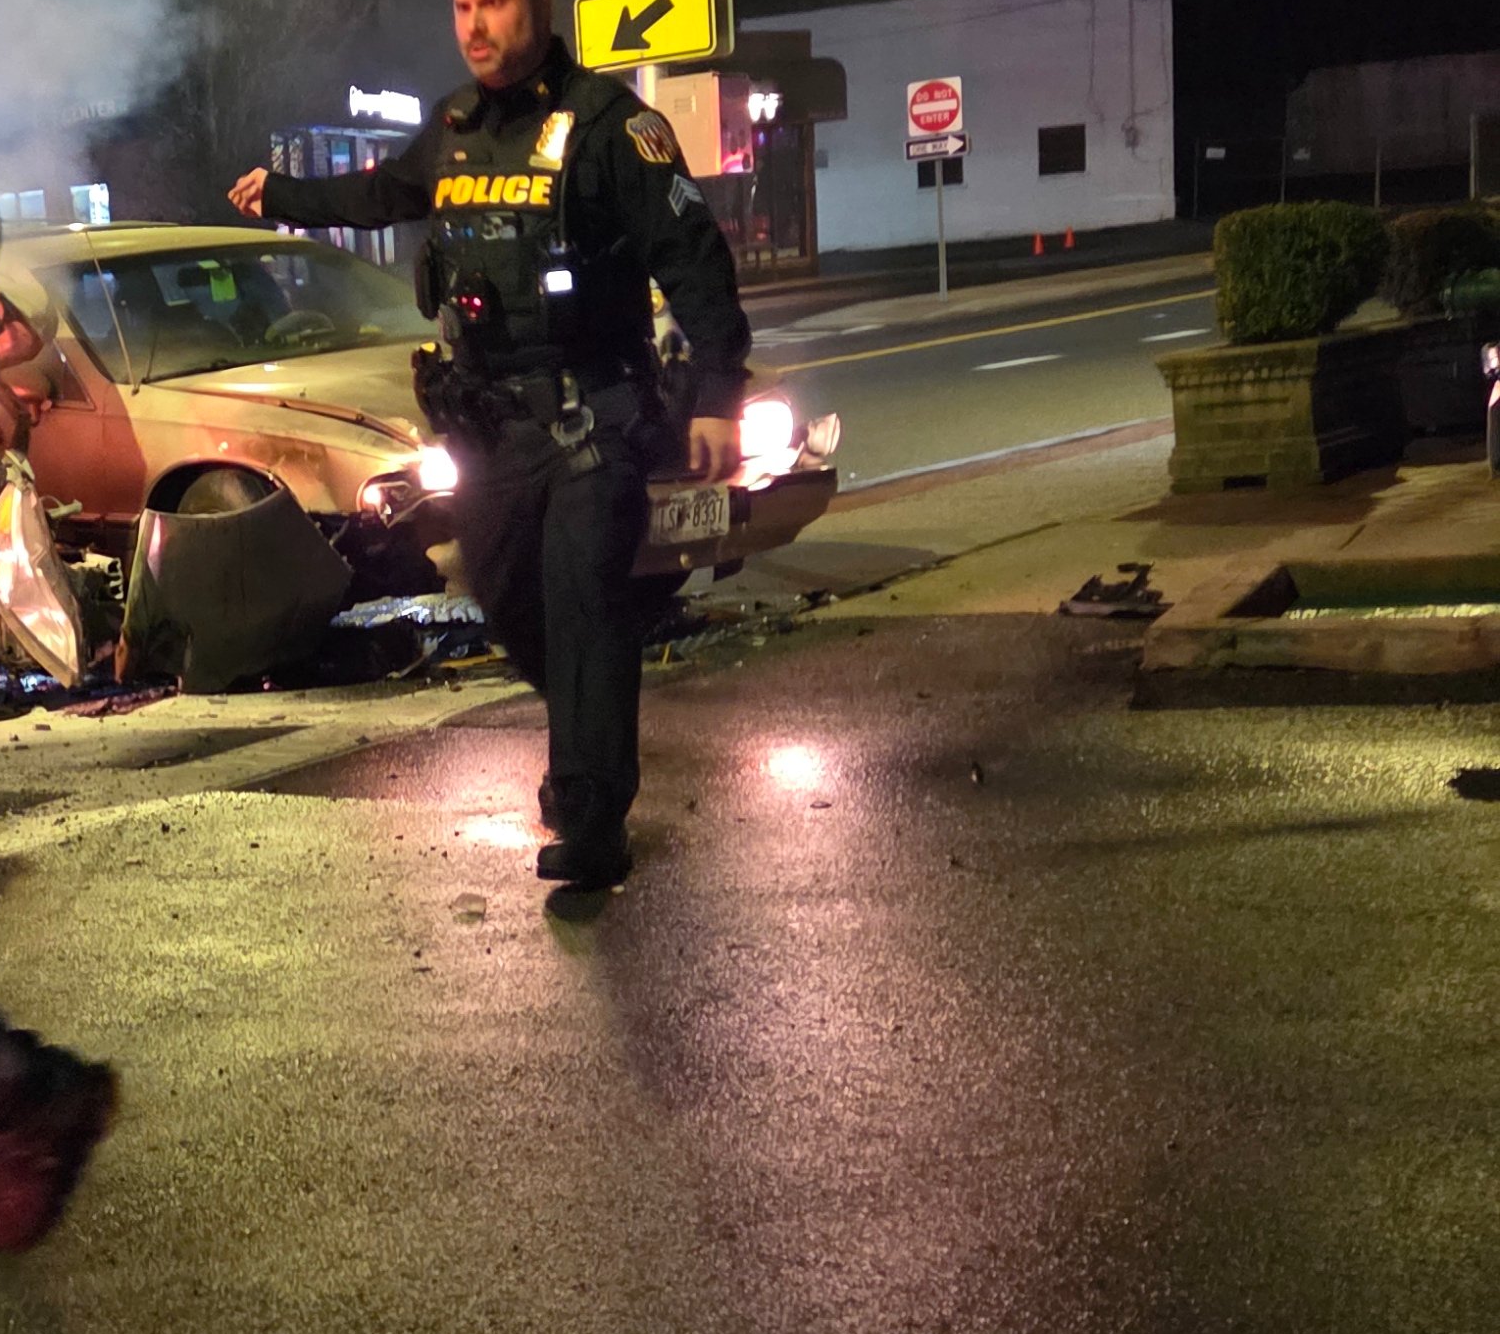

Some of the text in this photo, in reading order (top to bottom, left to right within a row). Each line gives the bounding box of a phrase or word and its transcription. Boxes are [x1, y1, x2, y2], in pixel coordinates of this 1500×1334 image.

[915, 88, 952, 103] DO NOT
[919, 111, 950, 126] ENTER
[435, 174, 553, 208] POLICE
